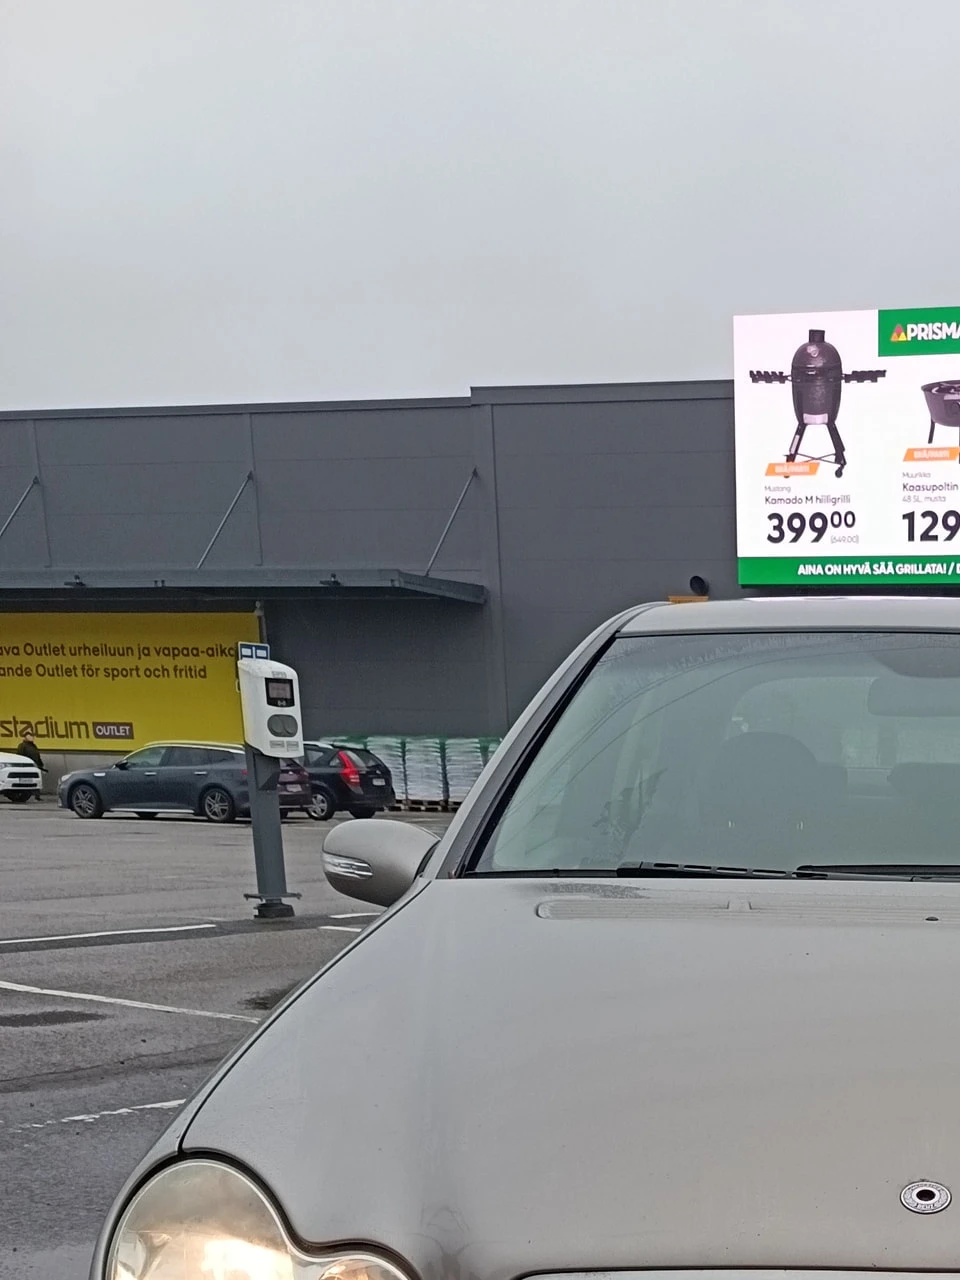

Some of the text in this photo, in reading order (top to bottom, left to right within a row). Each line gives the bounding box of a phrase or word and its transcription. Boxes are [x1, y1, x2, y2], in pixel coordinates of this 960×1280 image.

[902, 482, 959, 494] Kaasupoltin
[805, 496, 814, 504] M
[797, 564, 824, 575] AINA
[824, 564, 842, 575] ON
[843, 562, 872, 575] HYVÄ
[895, 562, 947, 575] GRILLATA!
[23, 642, 66, 657] Outlet
[69, 643, 134, 657] urheiluun
[137, 643, 151, 660] ja
[35, 663, 78, 678] Outlet
[81, 664, 101, 678] för
[103, 665, 141, 681] sport
[143, 665, 170, 679] och
[173, 664, 207, 679] fritid
[0, 715, 130, 739] stadium OUTLET
